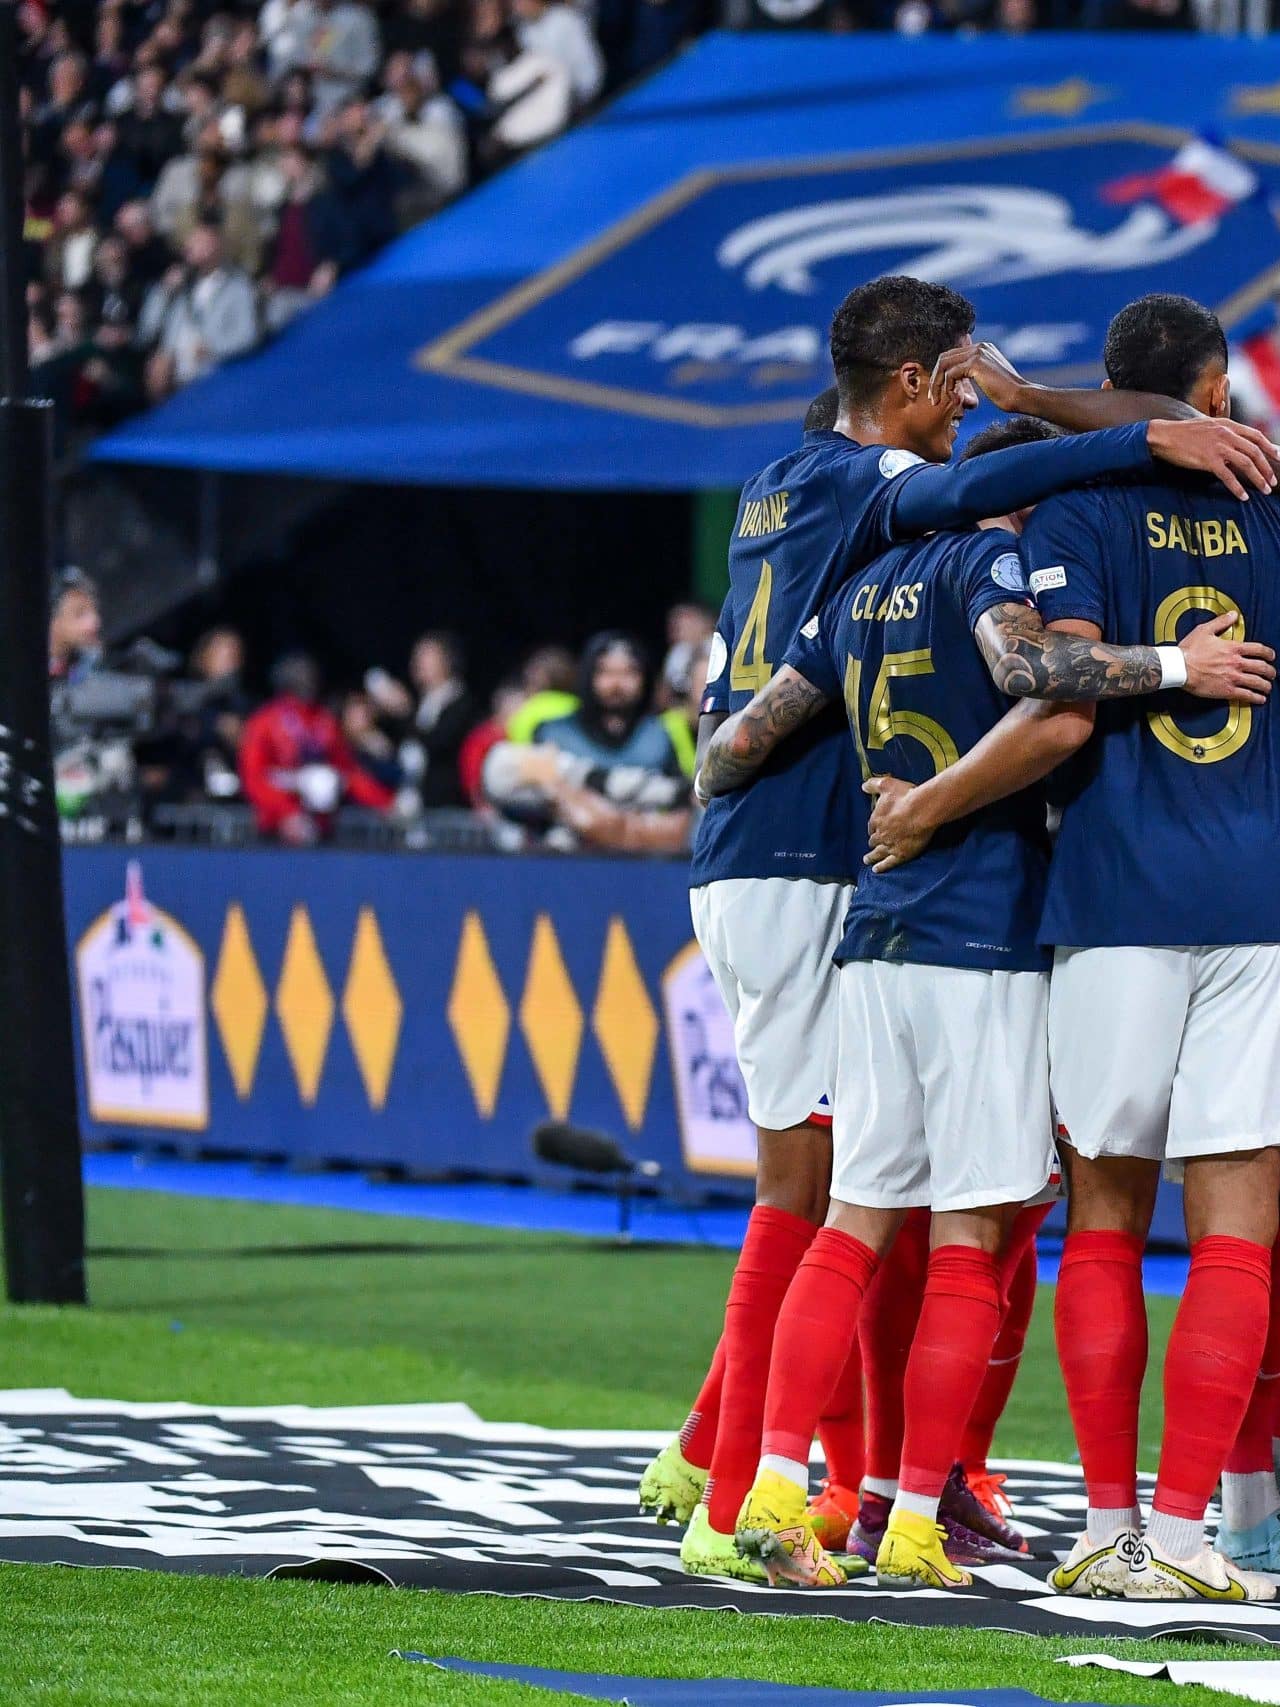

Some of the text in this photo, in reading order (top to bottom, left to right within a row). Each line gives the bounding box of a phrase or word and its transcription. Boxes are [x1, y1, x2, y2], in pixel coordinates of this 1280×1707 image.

[570, 319, 1088, 364] FRAE
[730, 558, 773, 696] 4
[843, 647, 961, 783] 15
